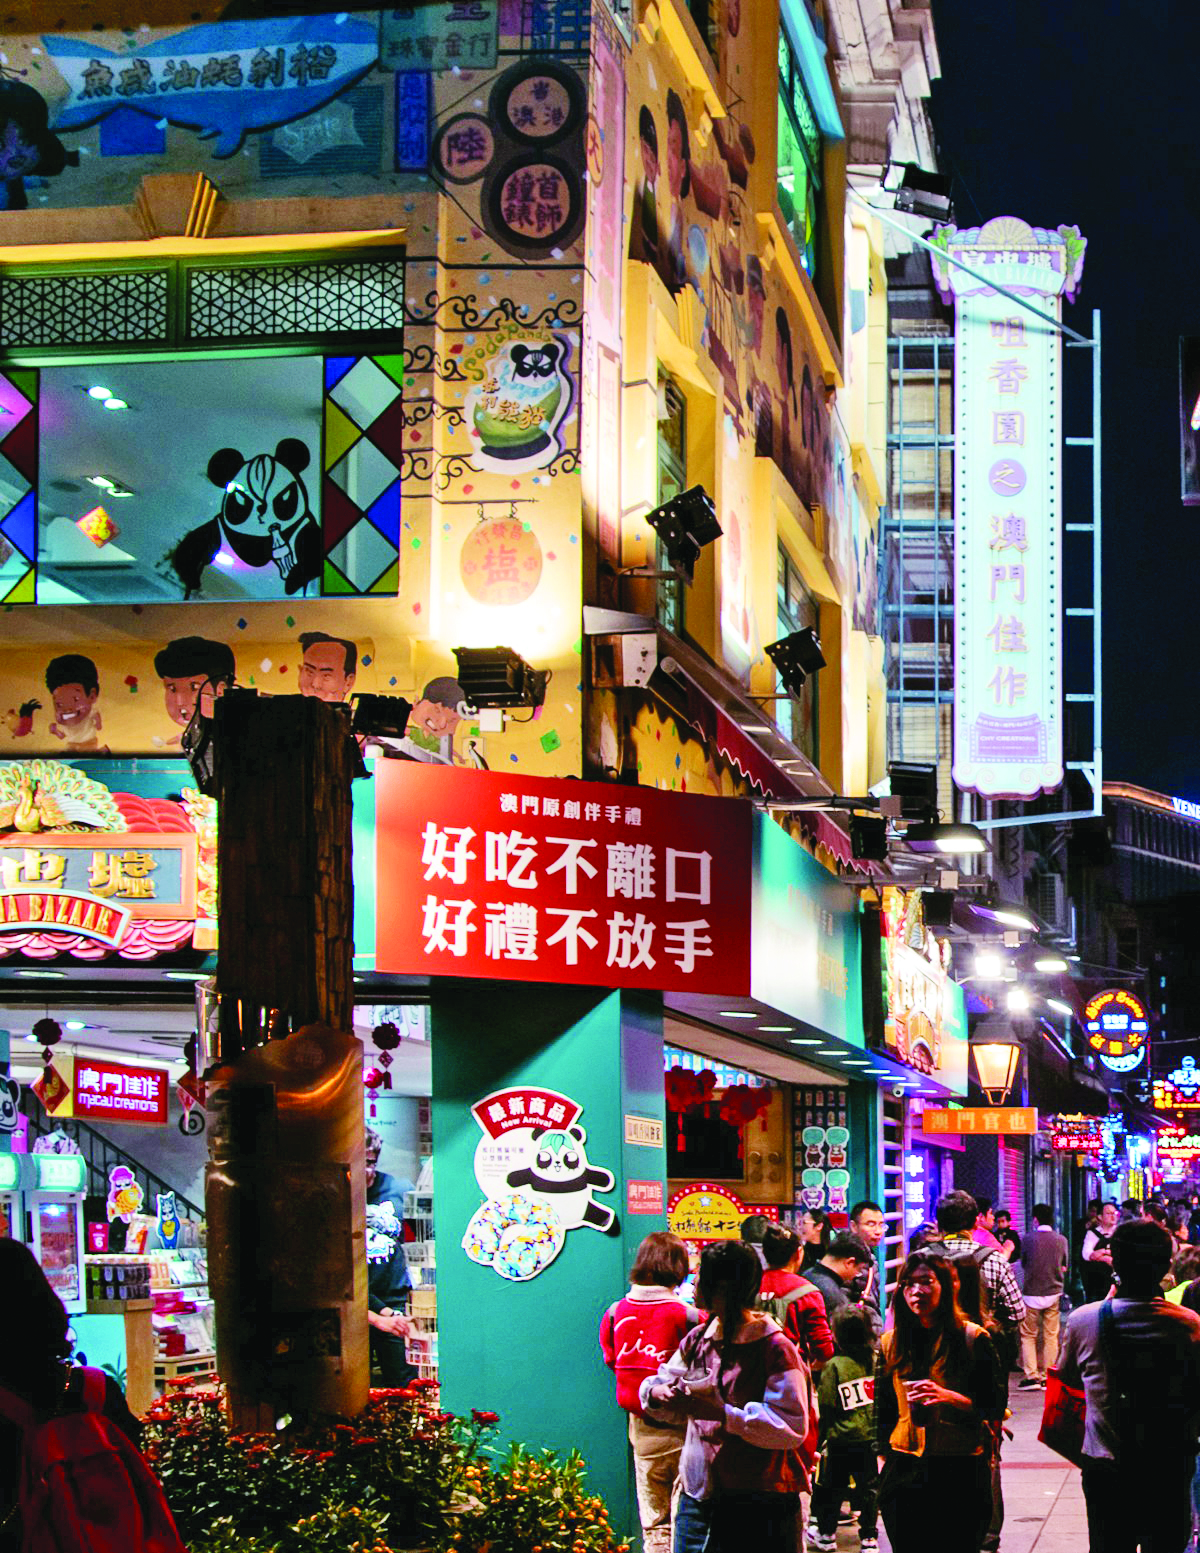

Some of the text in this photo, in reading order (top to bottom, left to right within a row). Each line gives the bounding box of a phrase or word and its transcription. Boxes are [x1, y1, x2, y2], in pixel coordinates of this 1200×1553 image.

[499, 792, 643, 827] 澳門原創伴手禮
[421, 821, 714, 906] 好吃不離口
[29, 893, 114, 934] BAZAAR
[421, 893, 715, 974] 好禮不放手
[78, 1068, 159, 1099] 澳門佳作
[487, 1096, 566, 1123] 最新商品
[501, 1116, 553, 1129] New Arrival
